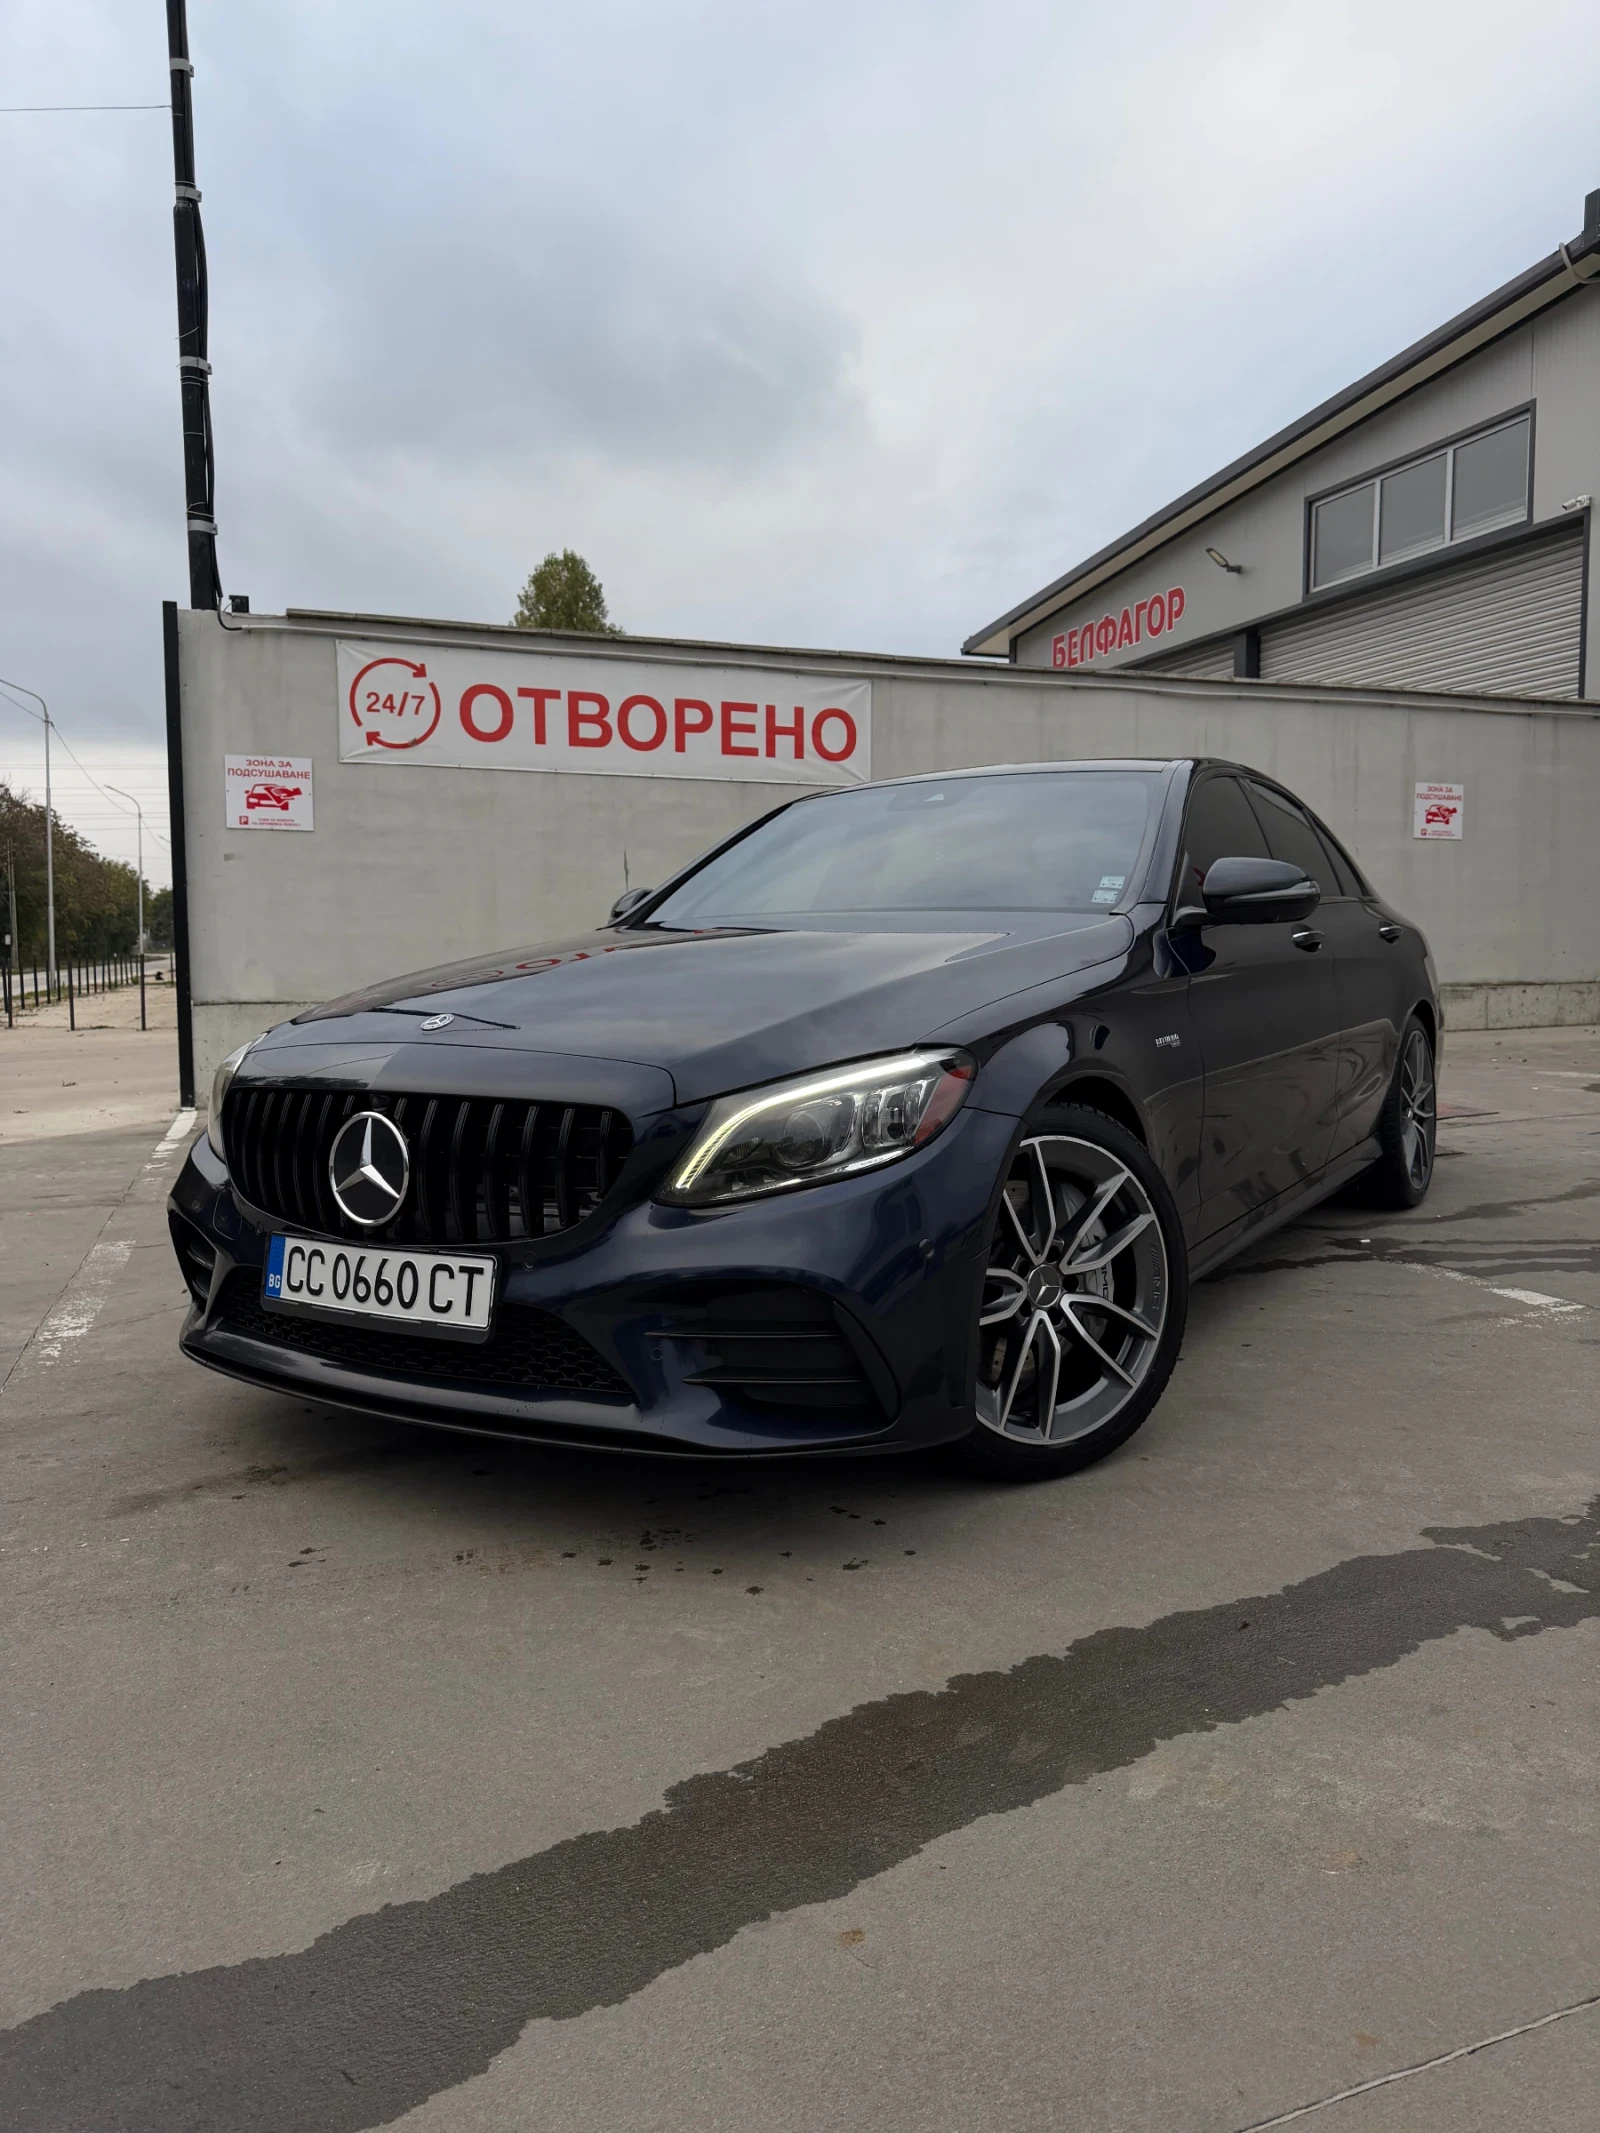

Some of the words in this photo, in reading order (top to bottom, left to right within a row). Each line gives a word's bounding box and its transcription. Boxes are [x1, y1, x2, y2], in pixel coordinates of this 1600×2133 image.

[1052, 586, 1185, 669] БЕЛФАГОР
[366, 692, 425, 716] 24/7
[459, 683, 857, 762] ОТВОРЕНО
[227, 768, 311, 779] ПОДСУШАВАНЕ
[246, 759, 275, 767] ЗОНА
[268, 1272, 281, 1289] BG
[286, 1246, 325, 1296] CC
[332, 1252, 420, 1310] 0660
[428, 1263, 485, 1317] CT
